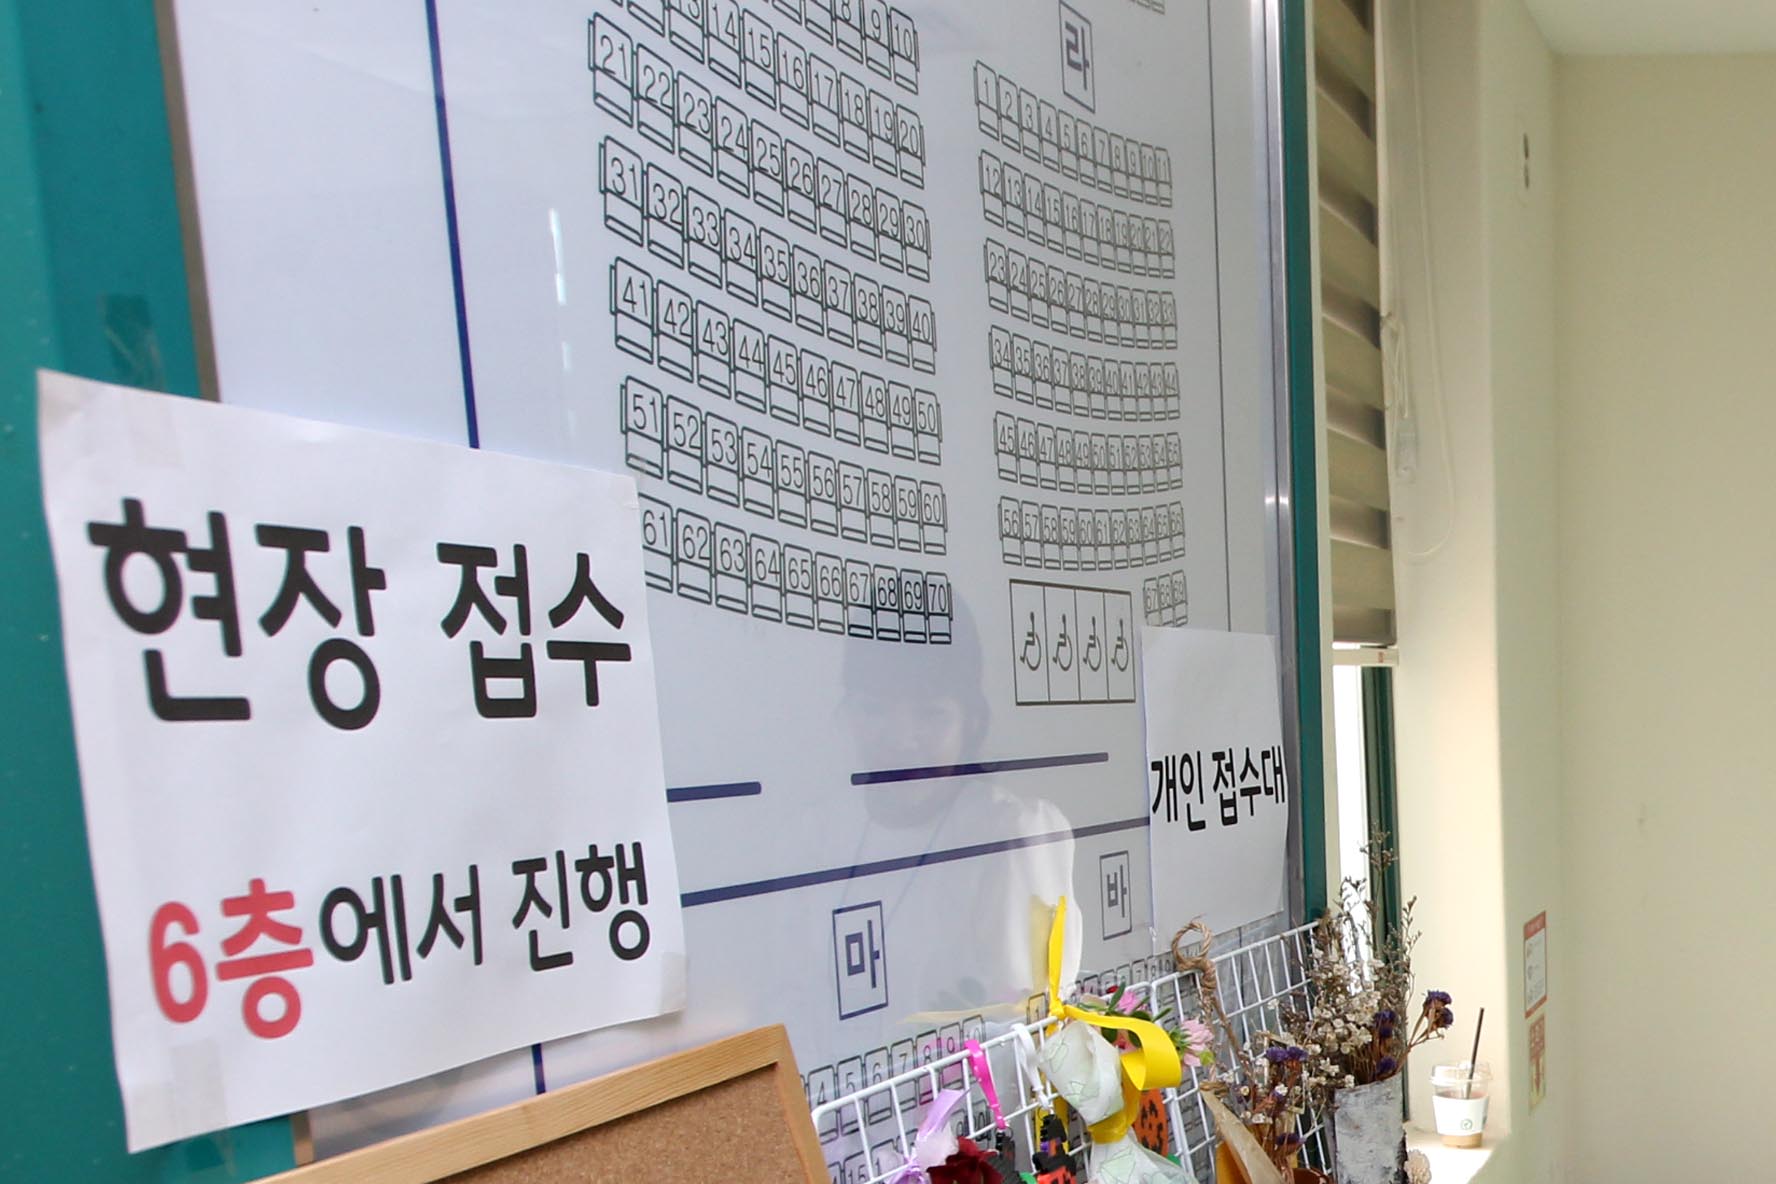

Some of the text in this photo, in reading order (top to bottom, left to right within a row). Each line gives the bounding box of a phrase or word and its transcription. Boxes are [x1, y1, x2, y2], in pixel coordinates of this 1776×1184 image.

[872, 9, 881, 42] 9
[894, 23, 913, 60] 10
[1065, 21, 1090, 91] 라
[712, 4, 737, 46] 14
[748, 28, 771, 68] 15
[782, 51, 804, 90] 16
[814, 72, 834, 109] 17
[845, 90, 865, 125] 18
[875, 106, 893, 142] 19
[900, 120, 919, 155] 20
[601, 35, 925, 249] 21 22 23 24 25 26 27 28 29 30
[984, 78, 989, 105] 1
[1005, 91, 1013, 120] 2
[1025, 103, 1033, 134] 3
[1045, 115, 1053, 139] 4
[1064, 123, 1070, 150] 5
[1081, 132, 1088, 159] 6
[1099, 140, 1105, 165] 7
[1115, 145, 1120, 170] 8
[1130, 151, 1136, 175] 9
[986, 164, 1001, 197] 12
[1008, 178, 1021, 208] 13
[1028, 186, 1041, 215] 14
[1047, 197, 1060, 225] 15
[1066, 204, 1078, 232] 16
[1084, 211, 1094, 237] 17
[611, 157, 931, 343] 31 32 33 34 35 36 37 38 39 40
[990, 252, 1005, 286] 23
[1011, 262, 1026, 291] 24
[1031, 271, 1046, 299] 25
[1051, 278, 1064, 306] 26
[1069, 283, 1080, 311] 27
[1086, 289, 1098, 316] 28
[623, 276, 936, 432] 41 42 43 44 45 46 47 48 49 50
[994, 339, 1011, 369] 34
[1016, 347, 1030, 375] 35
[1035, 353, 1049, 380] 36
[1054, 359, 1067, 386] 37
[1072, 363, 1084, 390] 38
[1090, 366, 1102, 392] 39
[633, 394, 942, 523] 51 52 53 54 55 56 57 58 59 60
[1000, 424, 1014, 452] 45
[1020, 432, 1034, 457] 46
[1040, 437, 1053, 462] 47
[1059, 440, 1072, 465] 48
[1076, 442, 1088, 468] 49
[643, 509, 946, 612] 61 62 63 64 65 66 67 68 69 70
[1004, 509, 1019, 536] 56
[1024, 514, 1038, 539] 57
[1044, 516, 1057, 542] 58
[1062, 518, 1074, 544] 59
[1081, 519, 1091, 544] 60
[1097, 520, 1108, 544] 61
[86, 498, 631, 730] 현장 접수
[1151, 746, 1285, 832] 개인 접수대
[1107, 864, 1127, 918] 바
[148, 841, 651, 1039] 6층에서 진행
[845, 919, 880, 989] 마
